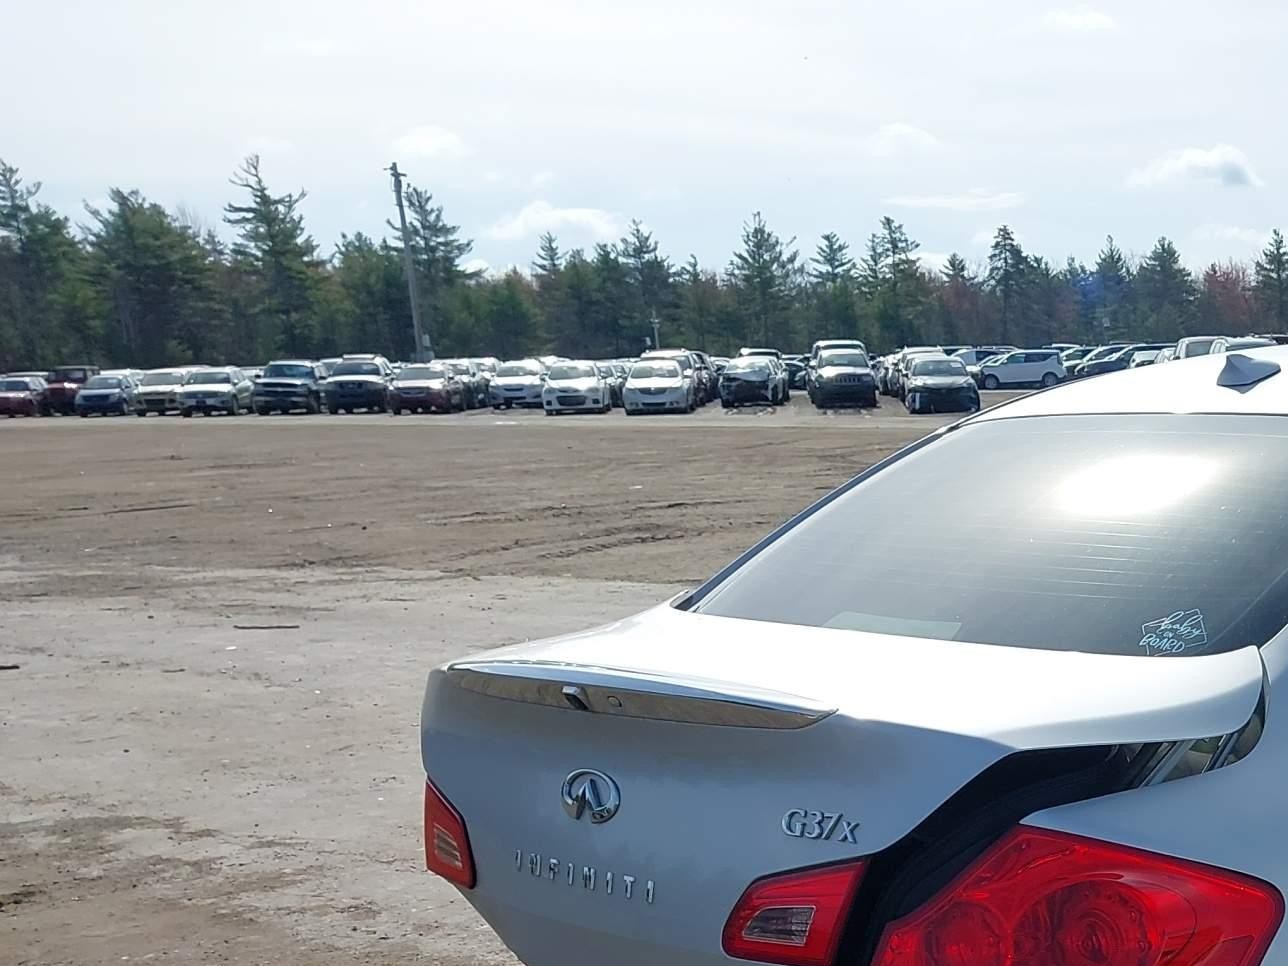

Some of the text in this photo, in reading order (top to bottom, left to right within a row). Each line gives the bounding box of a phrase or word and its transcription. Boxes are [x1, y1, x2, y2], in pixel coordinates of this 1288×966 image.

[1149, 610, 1207, 640] baby
[1138, 632, 1186, 653] BOARD
[515, 849, 655, 904] INFINITI
